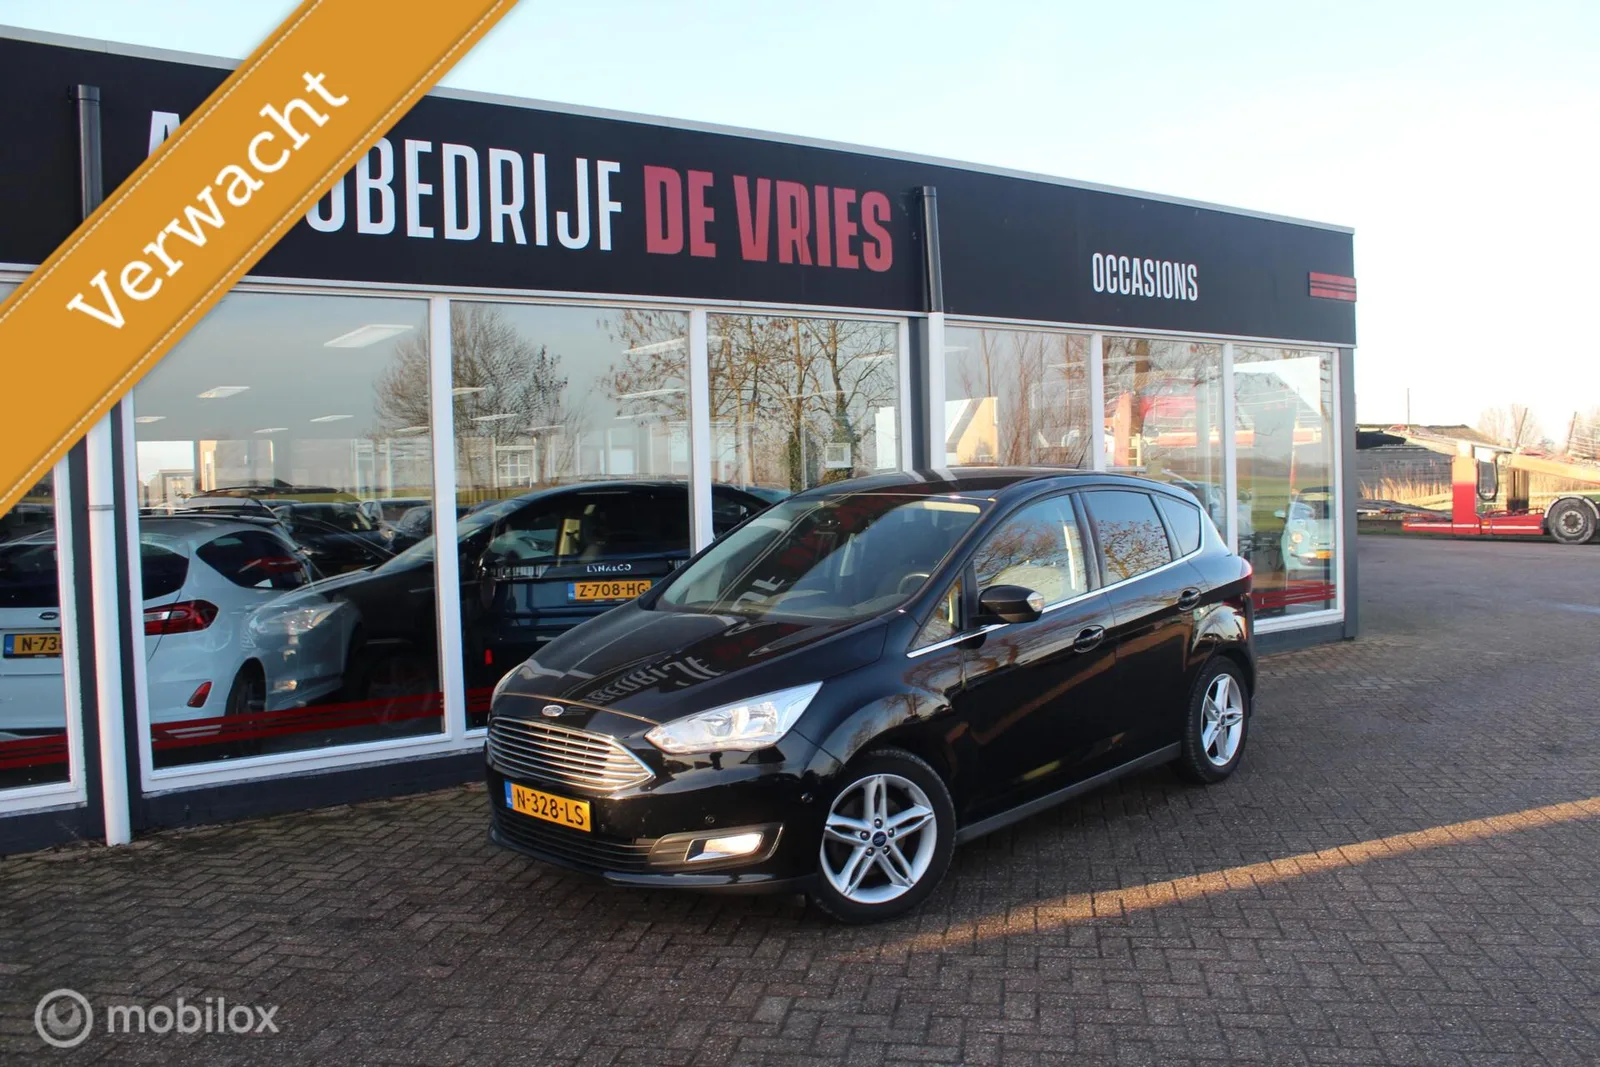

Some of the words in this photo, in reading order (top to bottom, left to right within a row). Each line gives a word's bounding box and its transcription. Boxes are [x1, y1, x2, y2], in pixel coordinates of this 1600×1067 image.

[148, 110, 622, 251] BEDRIJF
[644, 165, 716, 258] DE
[733, 174, 893, 272] VRIES
[1092, 252, 1198, 301] OCCASIONS
[516, 788, 584, 826] N-328-LS
